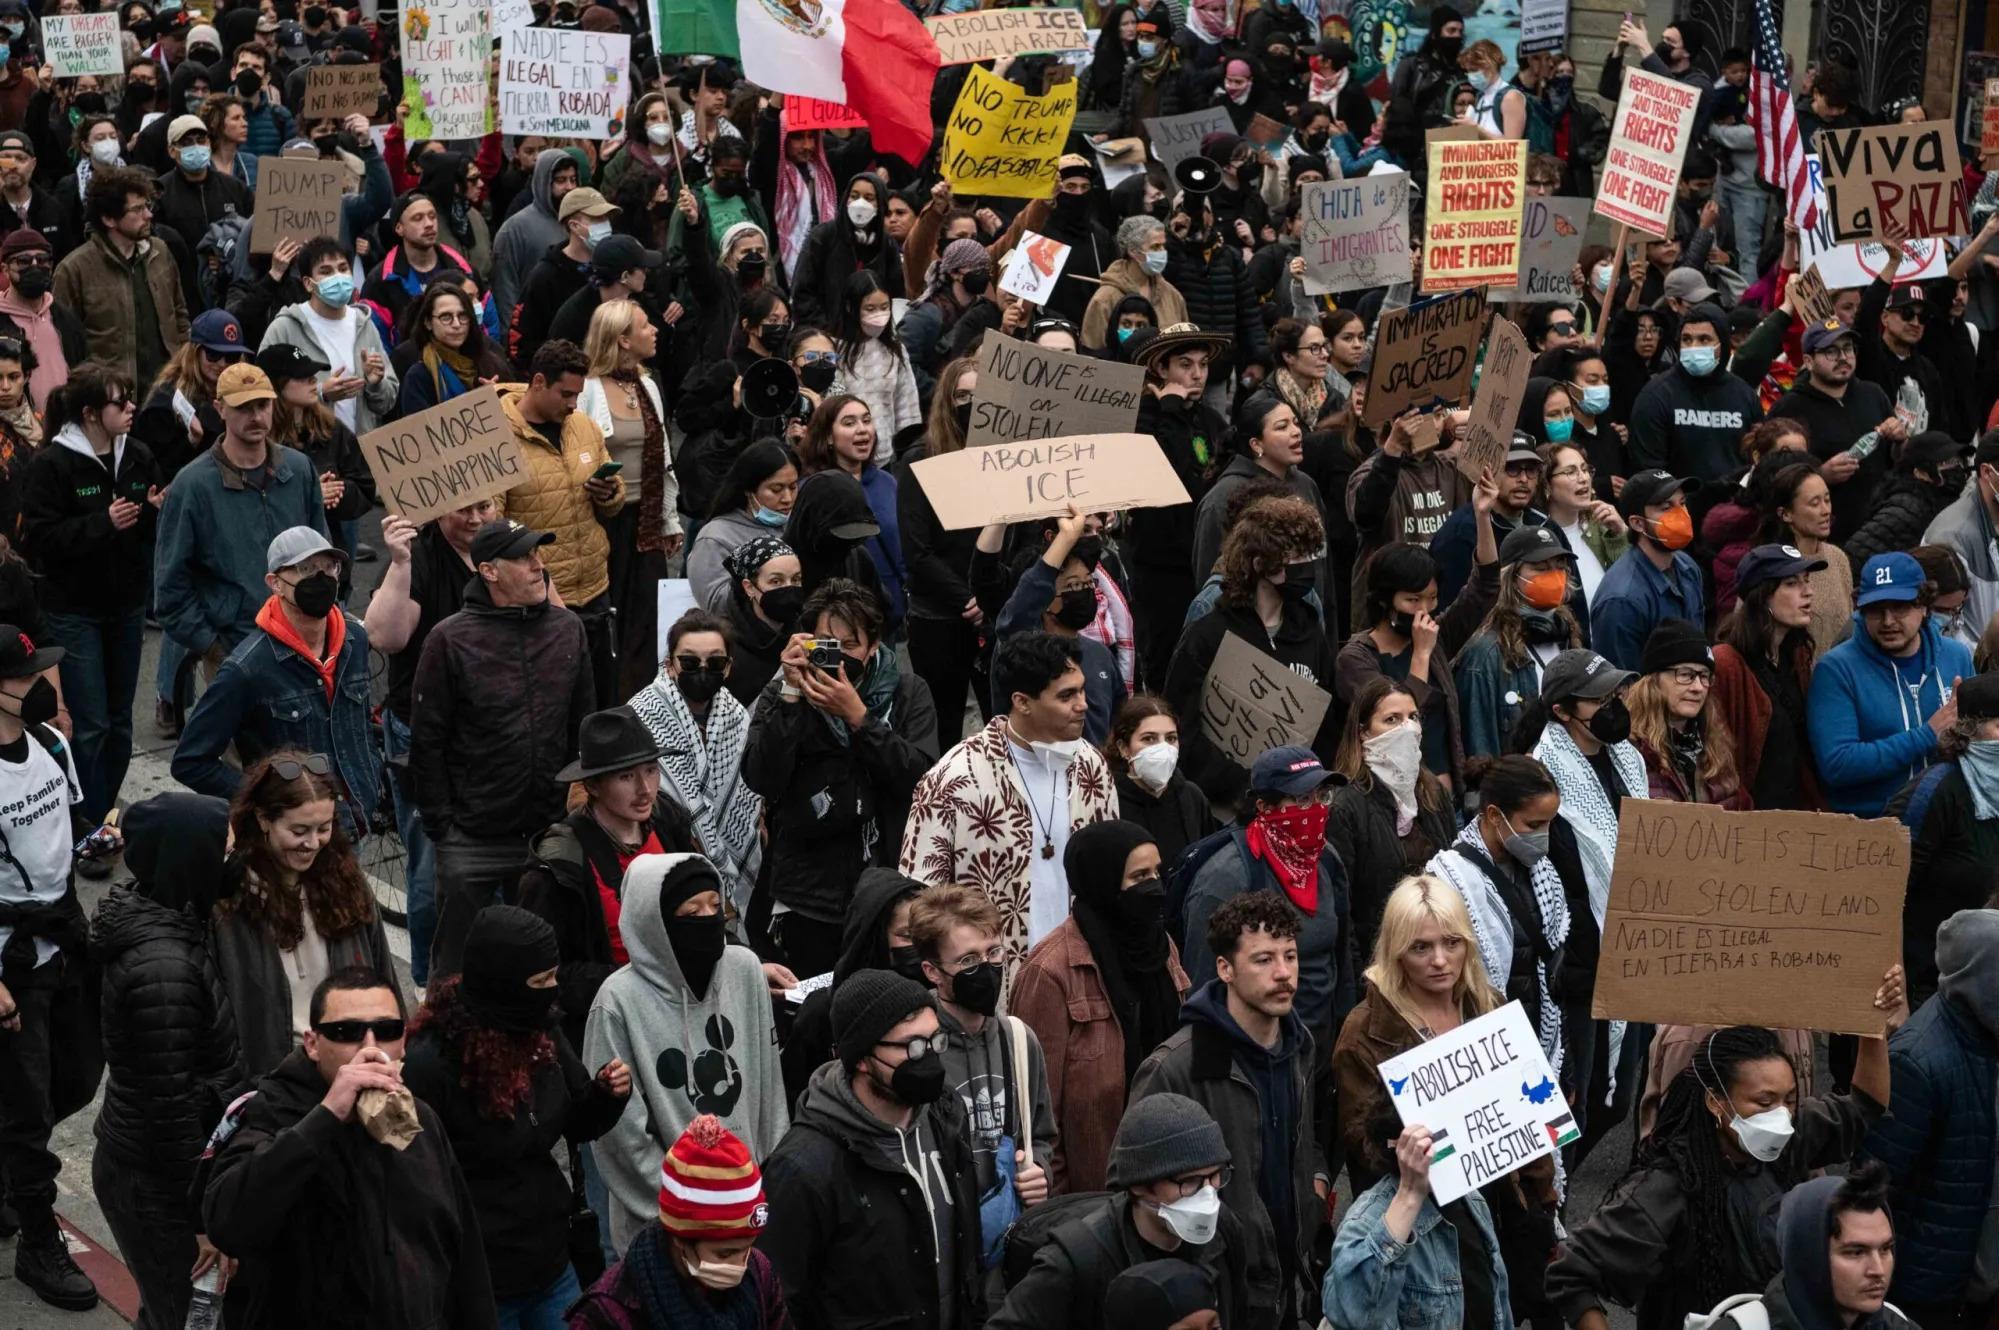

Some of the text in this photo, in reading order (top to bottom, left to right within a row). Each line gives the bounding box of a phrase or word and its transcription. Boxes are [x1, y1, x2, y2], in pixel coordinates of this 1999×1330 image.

[45, 16, 117, 32] MY DREAMS
[438, 14, 448, 35] I
[934, 11, 1080, 40] ABOLISH ICE
[46, 32, 114, 49] ARE BIGGER
[56, 47, 111, 61] THAN YOUR
[407, 39, 455, 61] FIGHT
[512, 29, 608, 65] NADIE ES
[941, 32, 1089, 61] VIVA LA RAZA
[65, 60, 113, 73] WALLS
[572, 66, 592, 90] EN
[504, 91, 611, 118] TIERRA ROBADA
[963, 74, 1073, 120] NO TRUMP
[1629, 74, 1695, 109] REPRODUCTIVE
[952, 108, 983, 136] NO
[1632, 95, 1682, 123] AND TRANS
[1623, 112, 1678, 153] RIGHTS
[1442, 142, 1519, 163] IMMIGRANT
[1610, 148, 1676, 186] ONE STRUGGLE
[268, 169, 337, 198] DUMP
[1440, 163, 1519, 180] AND WORKERS
[1321, 184, 1387, 220] HIJA de
[1441, 181, 1516, 212] RIGHTS
[1604, 170, 1671, 214] ONE FIGHT
[266, 206, 337, 235] TRUMP
[1828, 185, 1873, 241] La
[1318, 223, 1405, 265] IMIGRANTES
[1431, 220, 1518, 240] ONE STRUGGLE
[1429, 246, 1465, 270] ONE
[1469, 243, 1516, 268] FIGHT
[1421, 333, 1439, 356] IS
[988, 343, 1021, 382] NO
[1022, 356, 1078, 390] ONE
[1381, 345, 1467, 394] SACRED
[1074, 383, 1138, 410] ILLEGAL
[974, 402, 1064, 440] STOLEN
[1674, 408, 1744, 429] RAIDERS
[376, 400, 499, 473] NO MORE
[981, 442, 1096, 472] ABOLISH
[390, 441, 519, 516] KIDNAPPING
[1026, 468, 1089, 504] ICE
[1412, 490, 1446, 510] NO ONE
[1404, 516, 1415, 534] IS
[1875, 566, 1893, 585] 21
[1201, 663, 1282, 741] ICE at
[26, 776, 65, 806] Families
[11, 797, 61, 828] Together
[1634, 814, 1901, 872] NO ONE IS ILLEGAL
[1628, 876, 1673, 914] ON
[1820, 893, 1881, 917] LAND
[1615, 922, 1773, 951] NADIE ES ILEGAL
[1623, 951, 1842, 978] EN TIERRAS ROBADAS
[1411, 1028, 1519, 1107] ABOLISH ICE
[1464, 1099, 1512, 1143] FREE
[1460, 1120, 1546, 1187] PALESTINE
